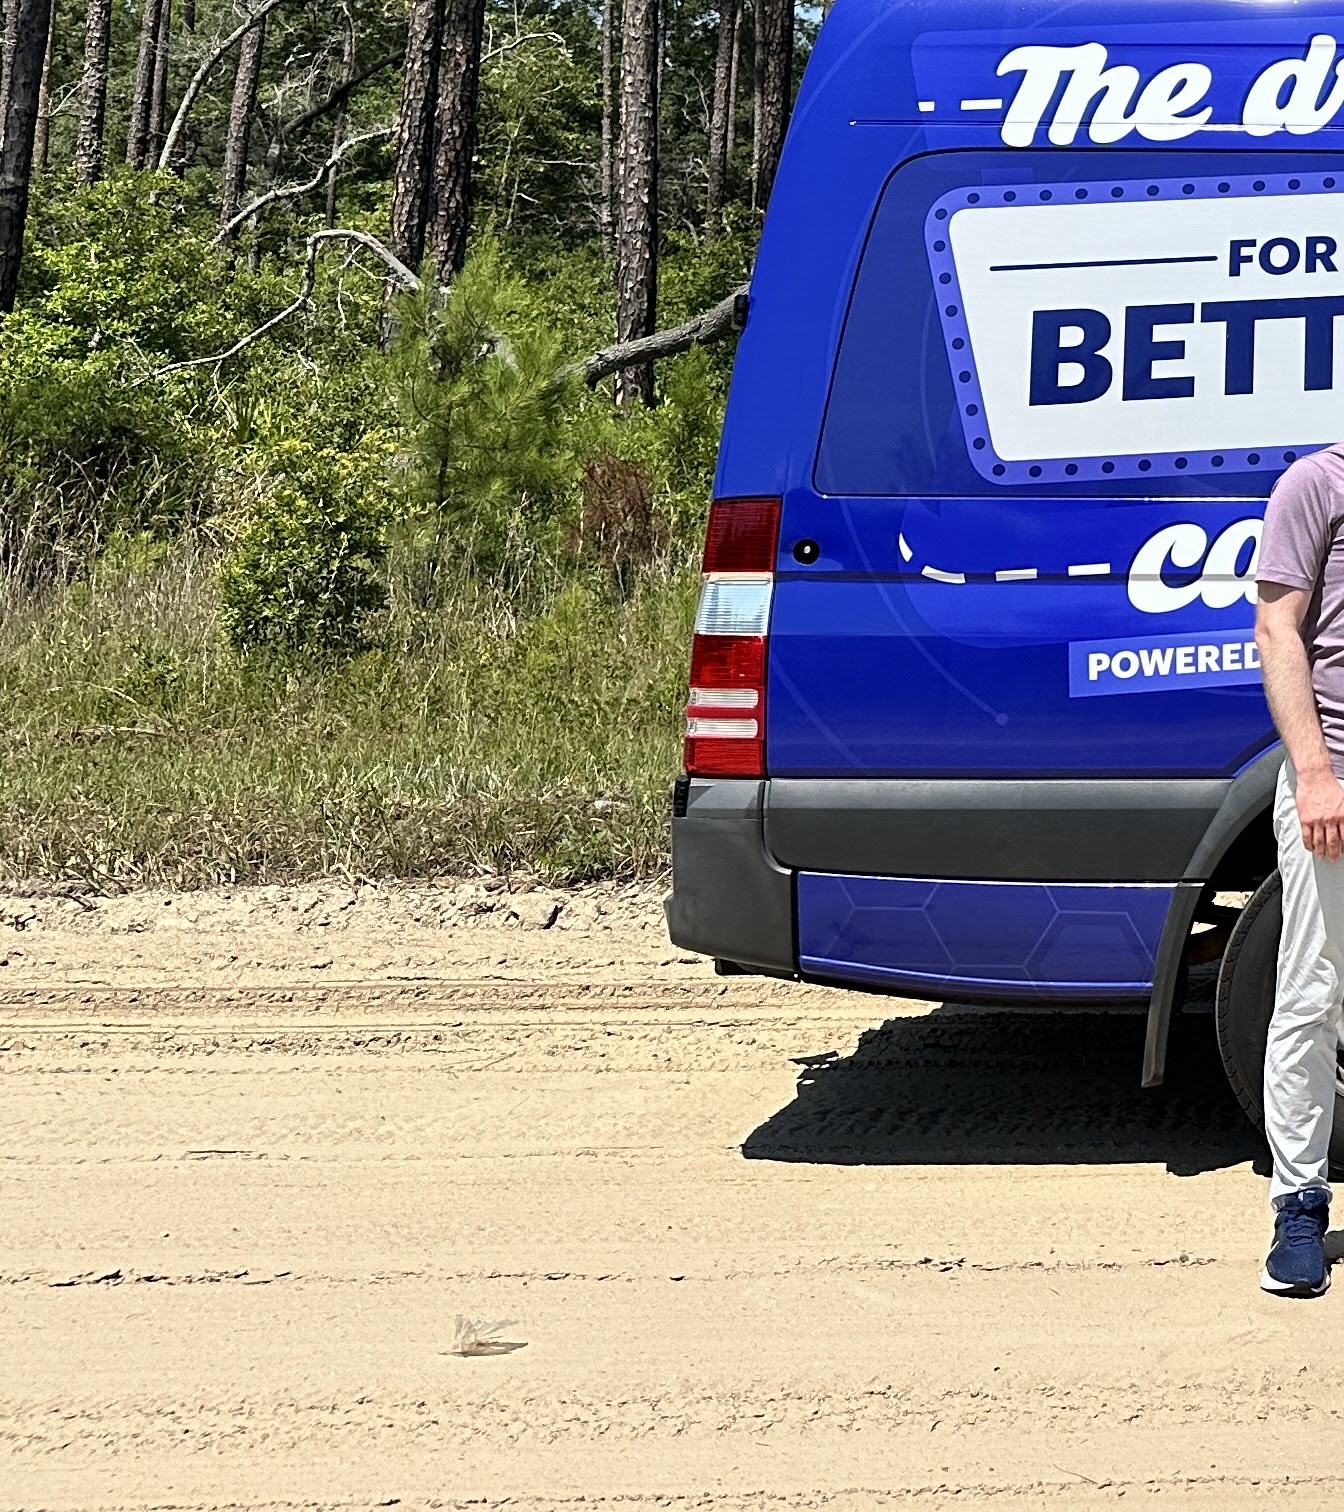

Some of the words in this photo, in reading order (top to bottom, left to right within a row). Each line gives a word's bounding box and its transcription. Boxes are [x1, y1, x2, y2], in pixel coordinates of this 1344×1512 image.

[996, 42, 1213, 147] The
[1227, 235, 1339, 277] FOR
[1127, 518, 1266, 614] ca
